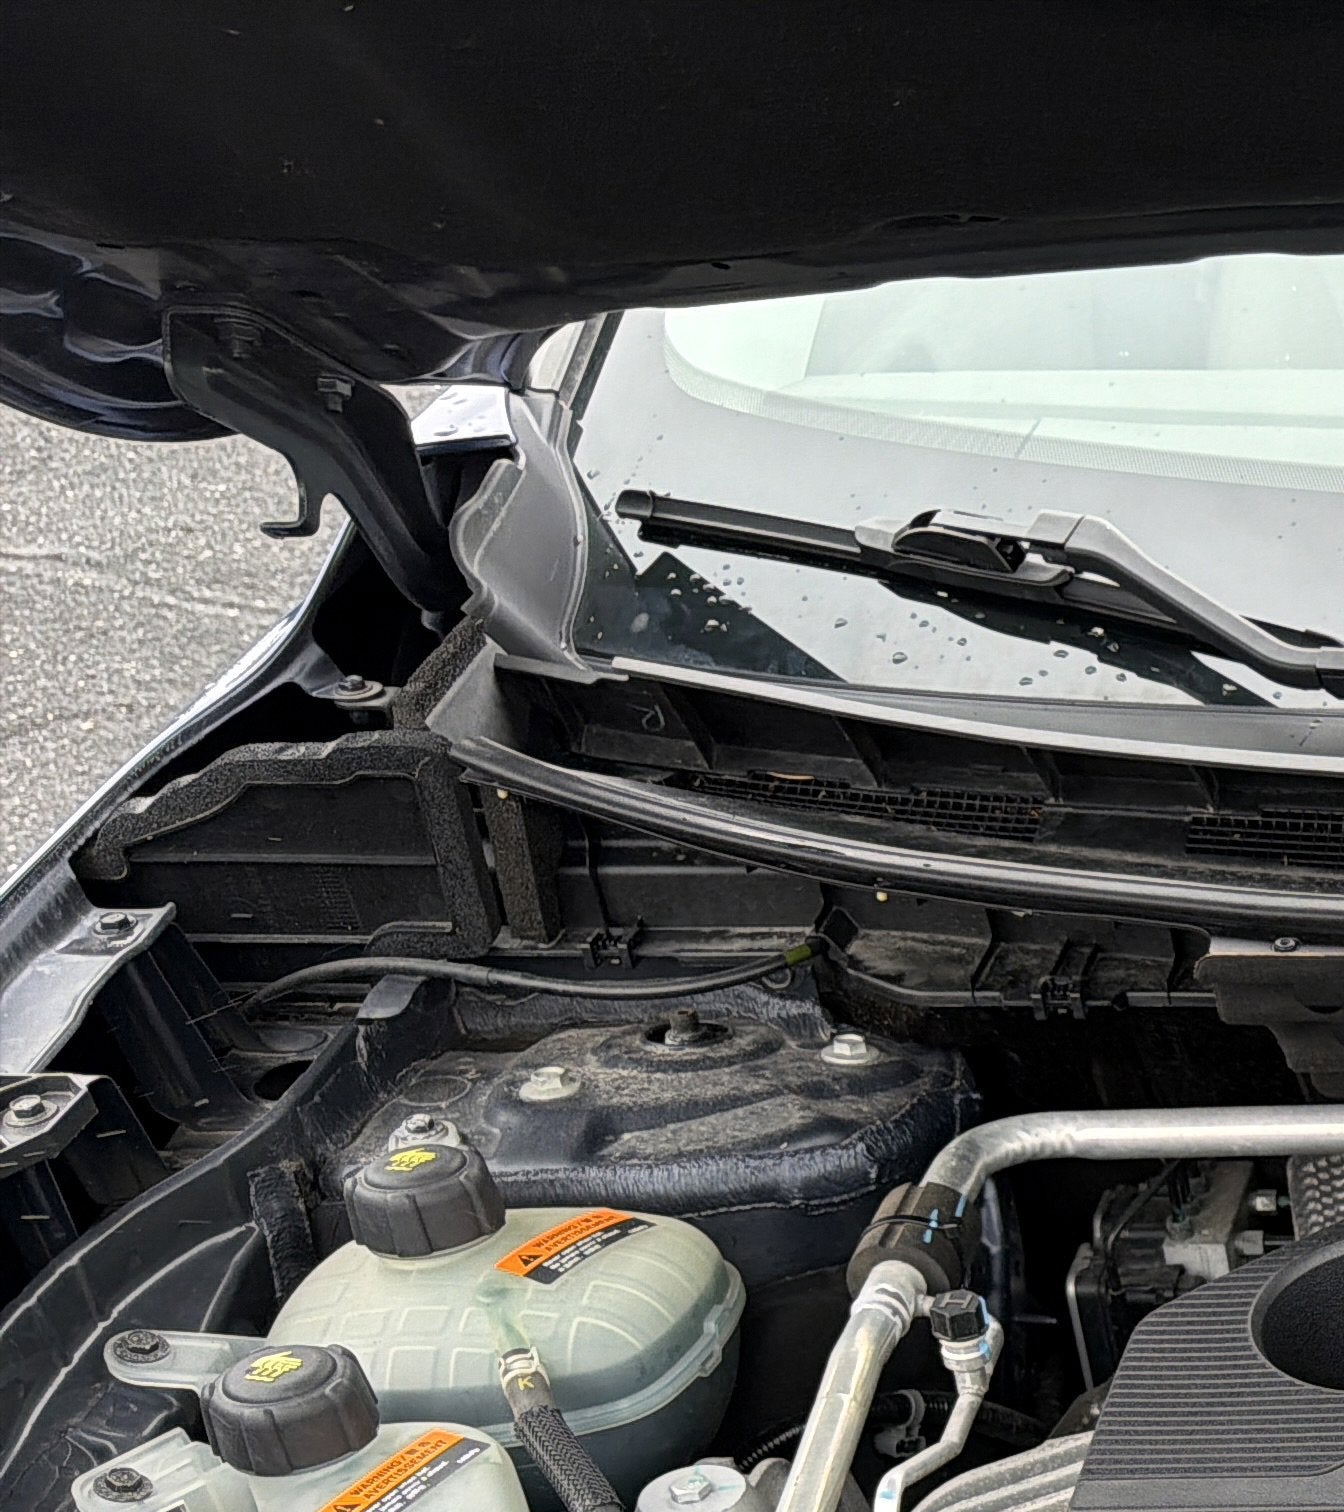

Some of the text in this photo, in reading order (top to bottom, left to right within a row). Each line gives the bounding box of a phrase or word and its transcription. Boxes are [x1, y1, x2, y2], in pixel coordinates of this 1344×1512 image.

[517, 1375, 535, 1391] K
[349, 1460, 402, 1496] WARNING
[363, 1439, 448, 1500] AVERTISSEMENT
